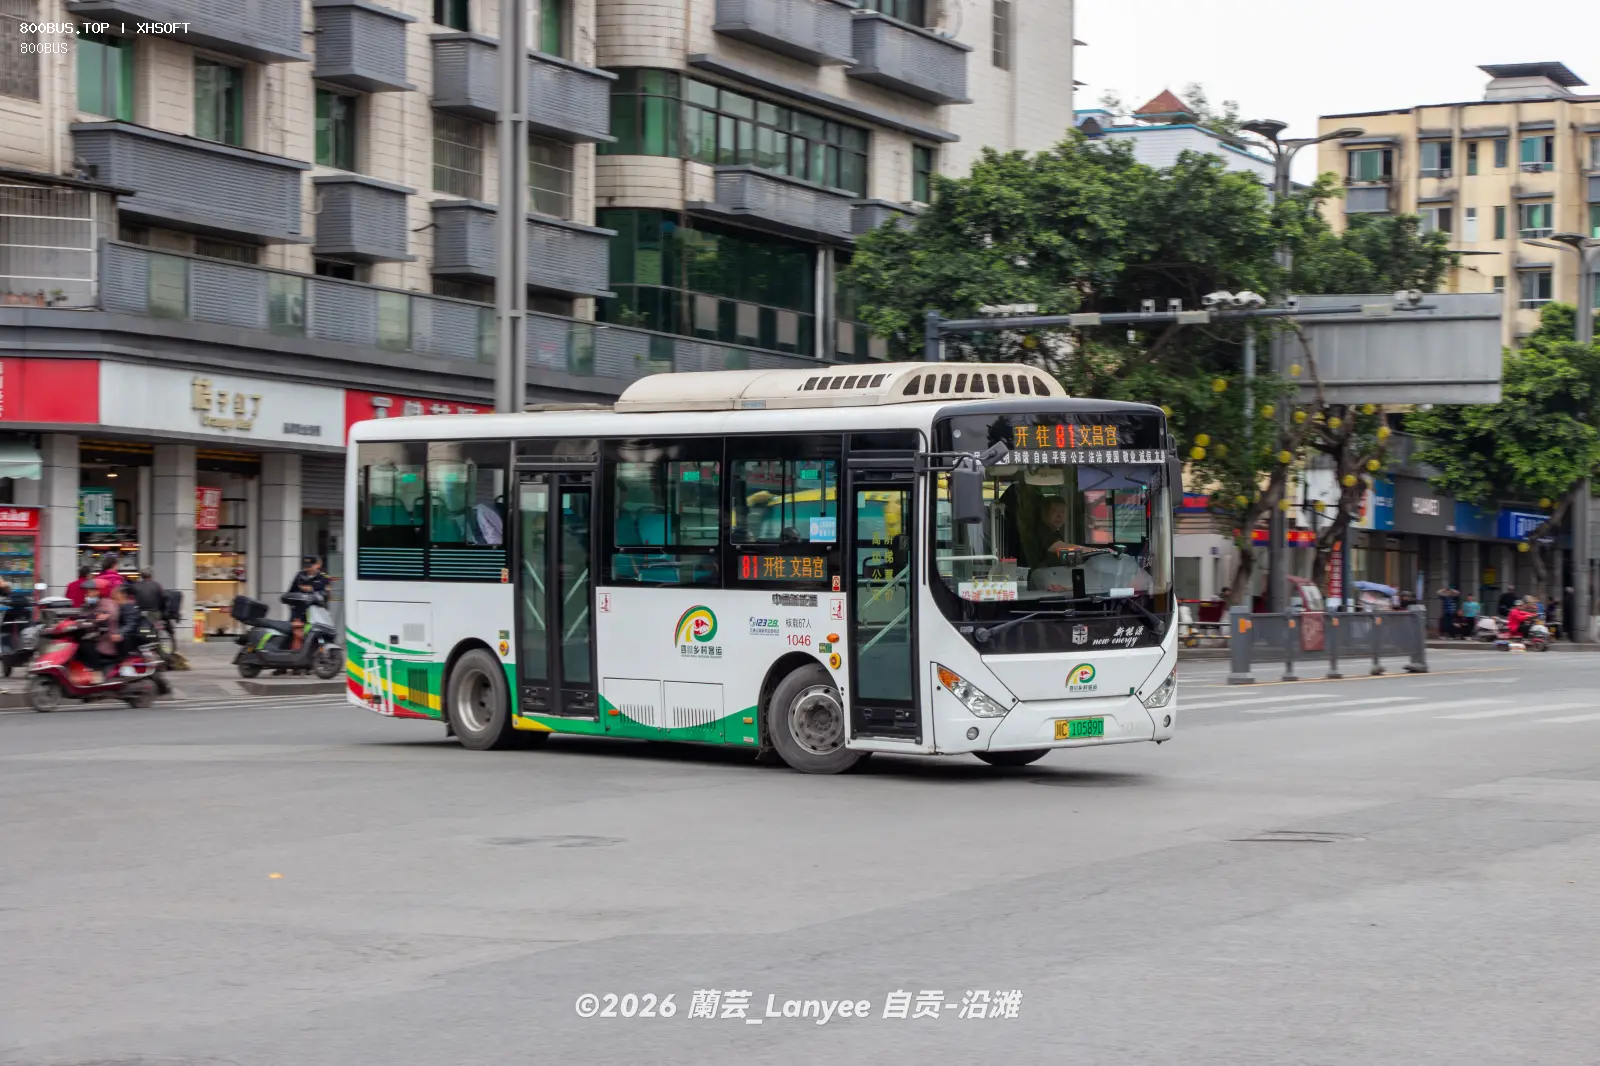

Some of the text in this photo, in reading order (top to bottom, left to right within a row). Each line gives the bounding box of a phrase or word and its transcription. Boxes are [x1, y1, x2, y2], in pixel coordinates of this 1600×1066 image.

[1079, 425, 1118, 447] 文昌宫
[1034, 451, 1048, 464] 自由
[1070, 451, 1085, 463] 公正
[763, 556, 786, 579] 开往
[790, 556, 824, 578] 文昌宫
[785, 617, 812, 629] 核载67人
[786, 634, 811, 647] 1046
[1092, 636, 1139, 648] new energy
